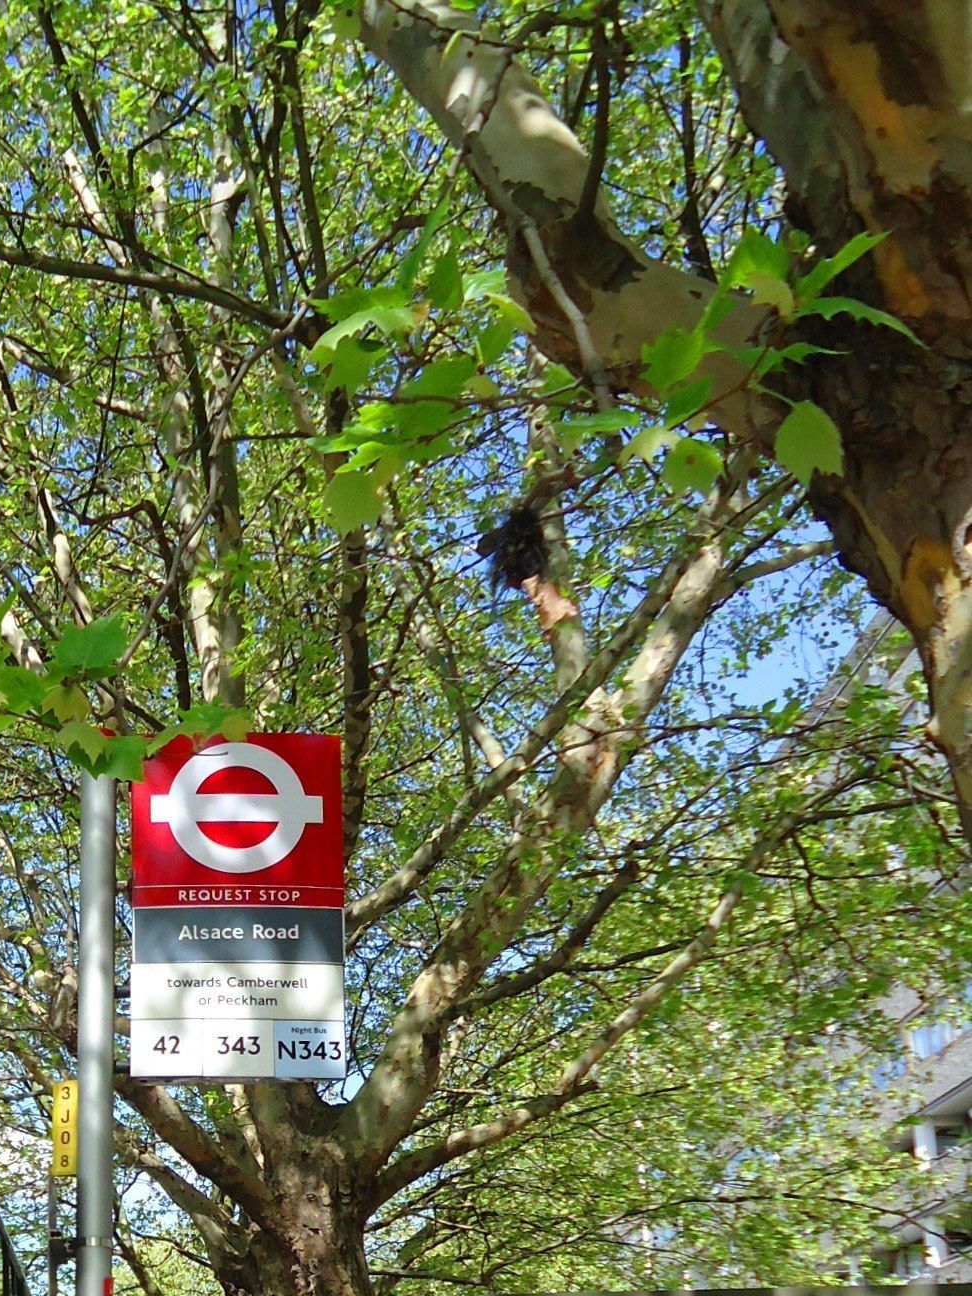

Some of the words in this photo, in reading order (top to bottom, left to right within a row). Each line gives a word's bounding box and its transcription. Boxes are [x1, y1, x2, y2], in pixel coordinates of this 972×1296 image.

[178, 890, 252, 901] REQUEST
[259, 890, 301, 901] STOP
[178, 925, 244, 940] Alsace
[252, 924, 299, 939] Road
[167, 978, 221, 988] towards
[227, 976, 308, 989] Camberwell
[198, 997, 211, 1005] or
[218, 995, 278, 1006] Peckham
[291, 1027, 312, 1035] Night
[153, 1036, 180, 1054] 42
[217, 1036, 261, 1055] 343
[278, 1041, 342, 1060] N343
